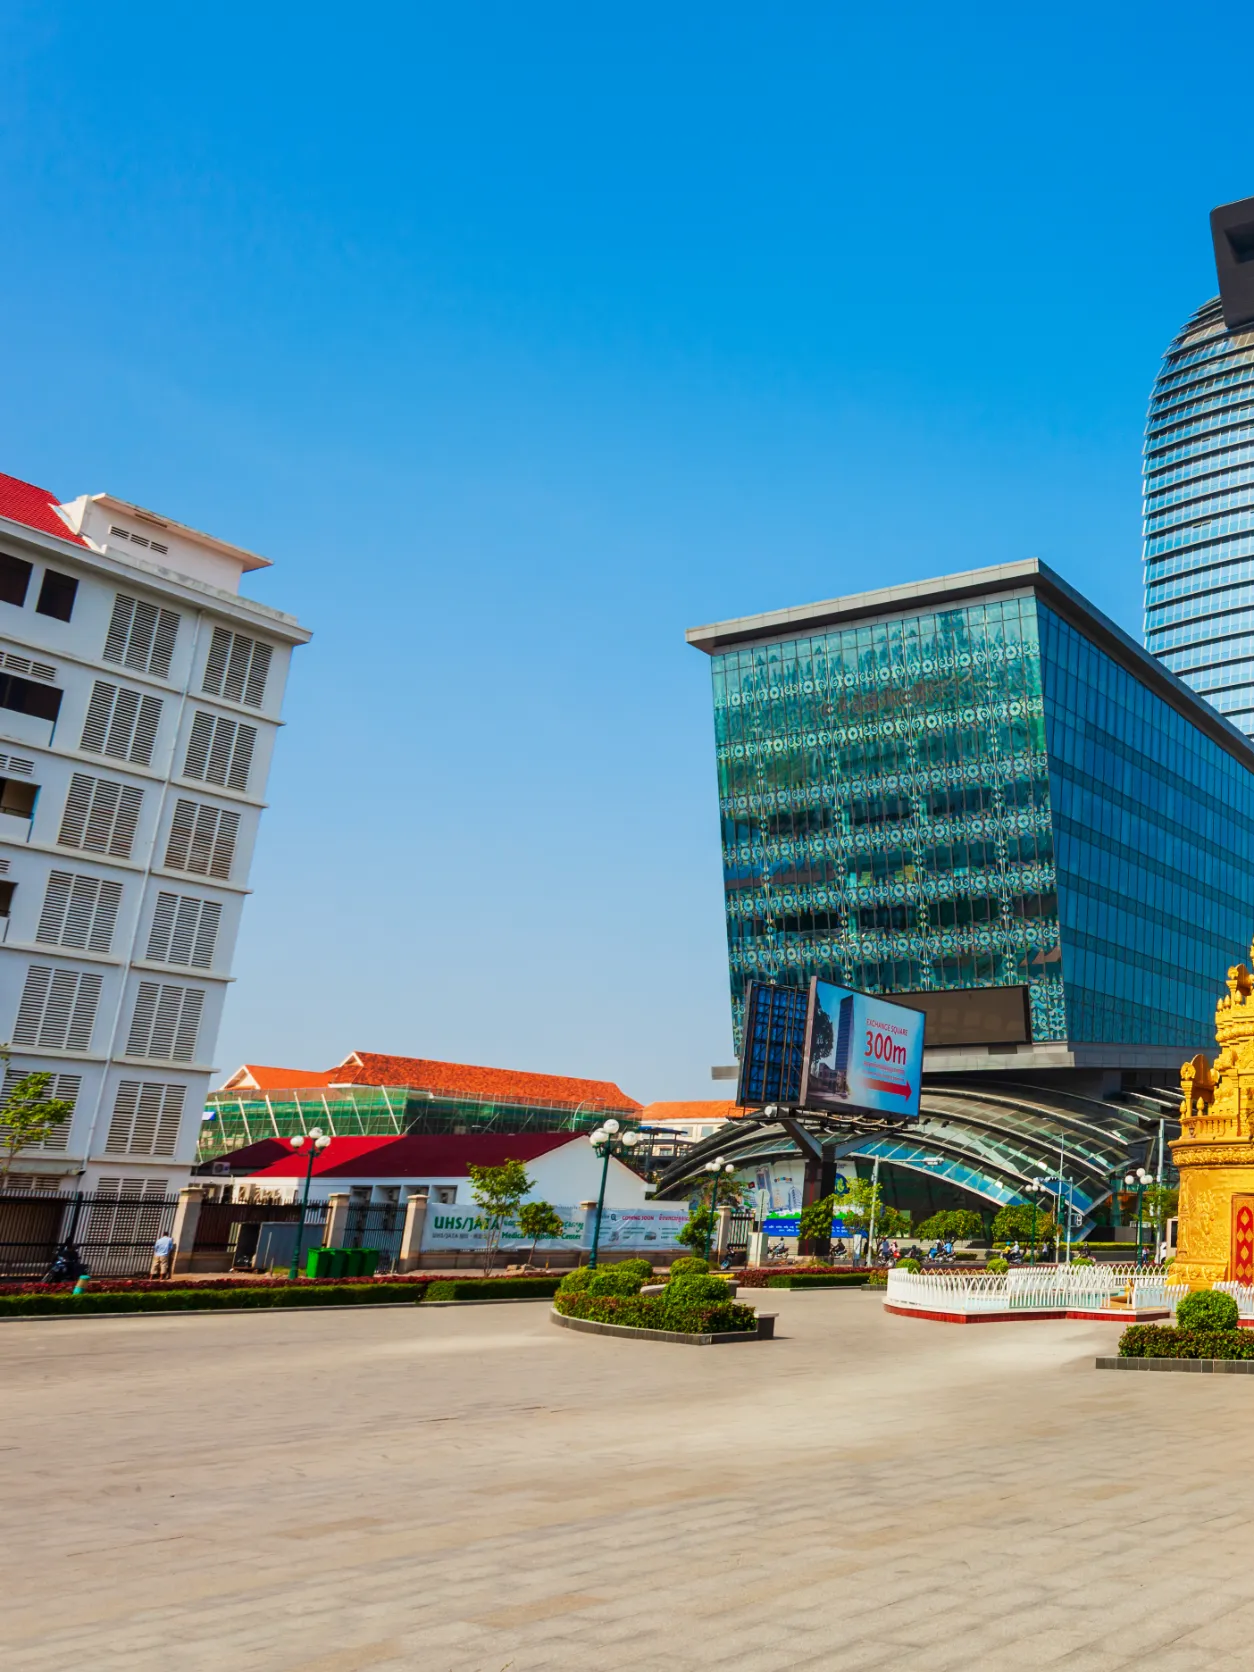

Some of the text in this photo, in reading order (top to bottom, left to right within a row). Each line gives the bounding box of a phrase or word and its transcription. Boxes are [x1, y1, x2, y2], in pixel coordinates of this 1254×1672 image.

[866, 1018, 908, 1036] EXCHANGE SQUARE
[864, 1031, 906, 1065] 300m
[561, 1232, 582, 1241] Center
